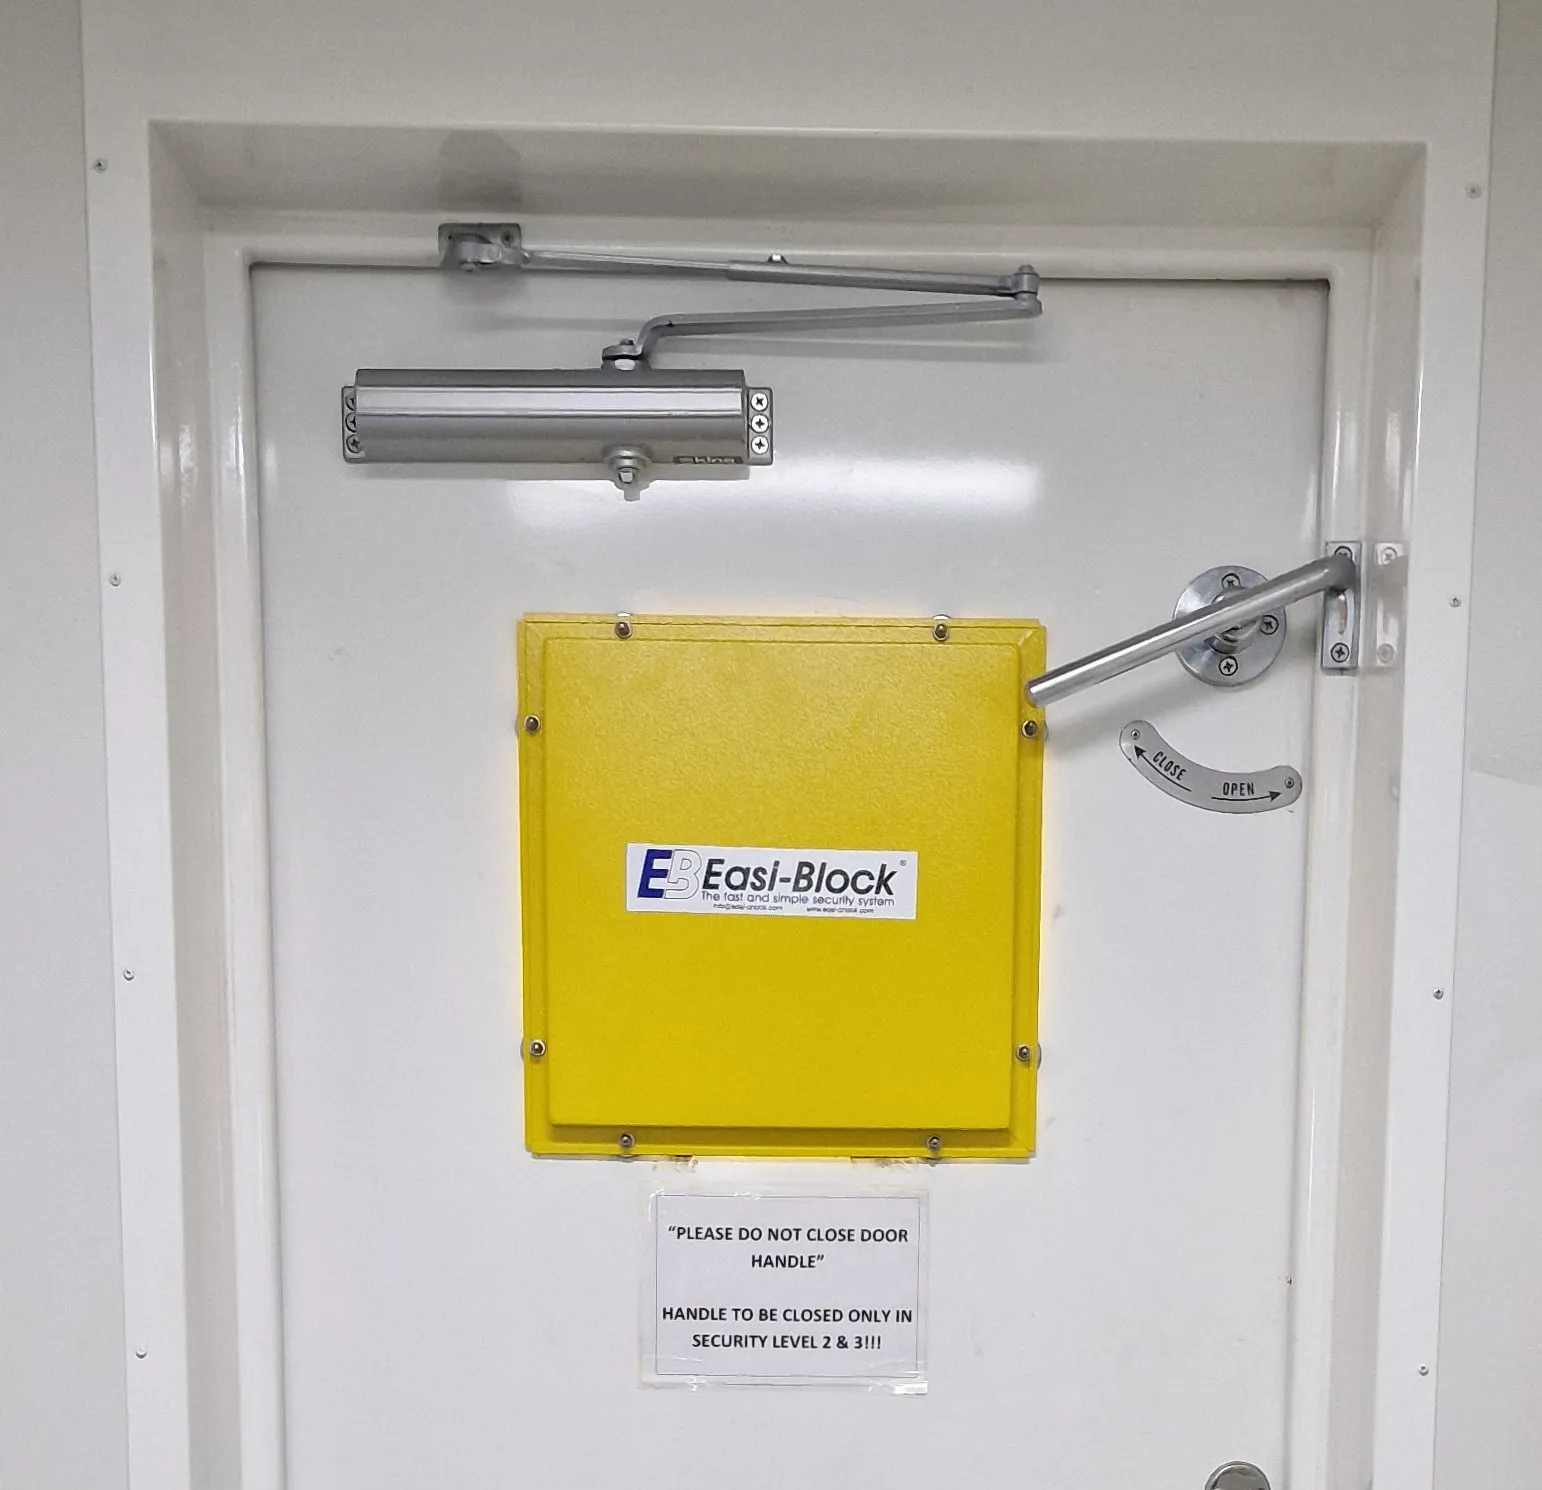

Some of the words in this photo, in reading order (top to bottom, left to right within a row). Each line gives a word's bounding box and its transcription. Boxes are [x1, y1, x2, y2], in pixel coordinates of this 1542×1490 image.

[1152, 751, 1186, 781] CLOSE
[1223, 782, 1255, 796] OPEN
[702, 858, 897, 896] Easi-Block
[701, 891, 720, 901] The
[724, 891, 744, 902] fast
[747, 893, 766, 903] and
[773, 893, 809, 905] simple
[812, 894, 855, 906] security
[858, 897, 895, 907] system
[668, 1226, 733, 1240] “PLEASE
[738, 1228, 762, 1241] DO
[768, 1228, 801, 1241] NOT
[806, 1228, 855, 1242] CLOSE
[860, 1229, 908, 1242] DOOR
[751, 1254, 824, 1268] HANDLE”
[662, 1307, 727, 1321] HANDLE
[733, 1308, 753, 1321] TO
[759, 1308, 777, 1322] BE
[782, 1308, 843, 1322] CLOSED
[849, 1309, 891, 1322] ONLY
[895, 1310, 912, 1323] IN
[692, 1334, 768, 1348] SECURITY
[773, 1335, 818, 1348] LEVEL
[822, 1335, 831, 1349] 2
[836, 1336, 849, 1349] &
[854, 1336, 881, 1350] 3!!!
